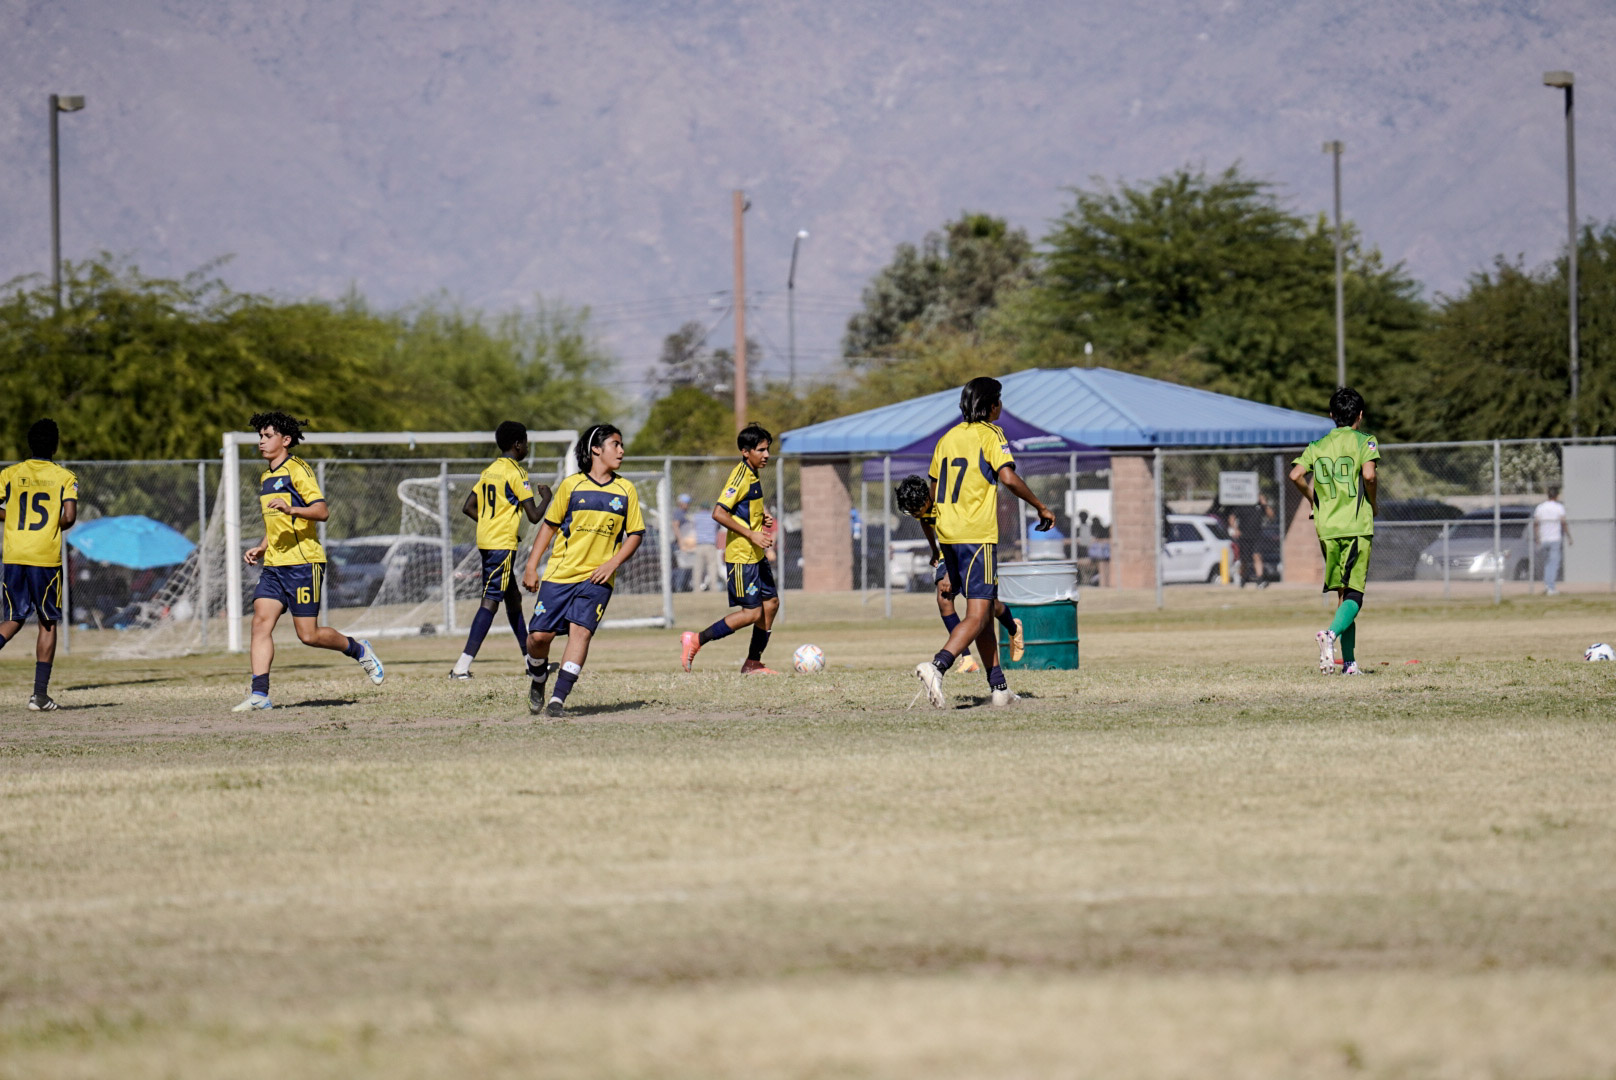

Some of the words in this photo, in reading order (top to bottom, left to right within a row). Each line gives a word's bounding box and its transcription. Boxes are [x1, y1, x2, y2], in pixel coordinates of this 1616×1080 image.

[936, 456, 969, 504] 17
[1314, 455, 1357, 499] 99
[17, 491, 51, 531] 15
[482, 482, 497, 519] 19
[296, 586, 311, 604] 16
[596, 603, 604, 622] 4
